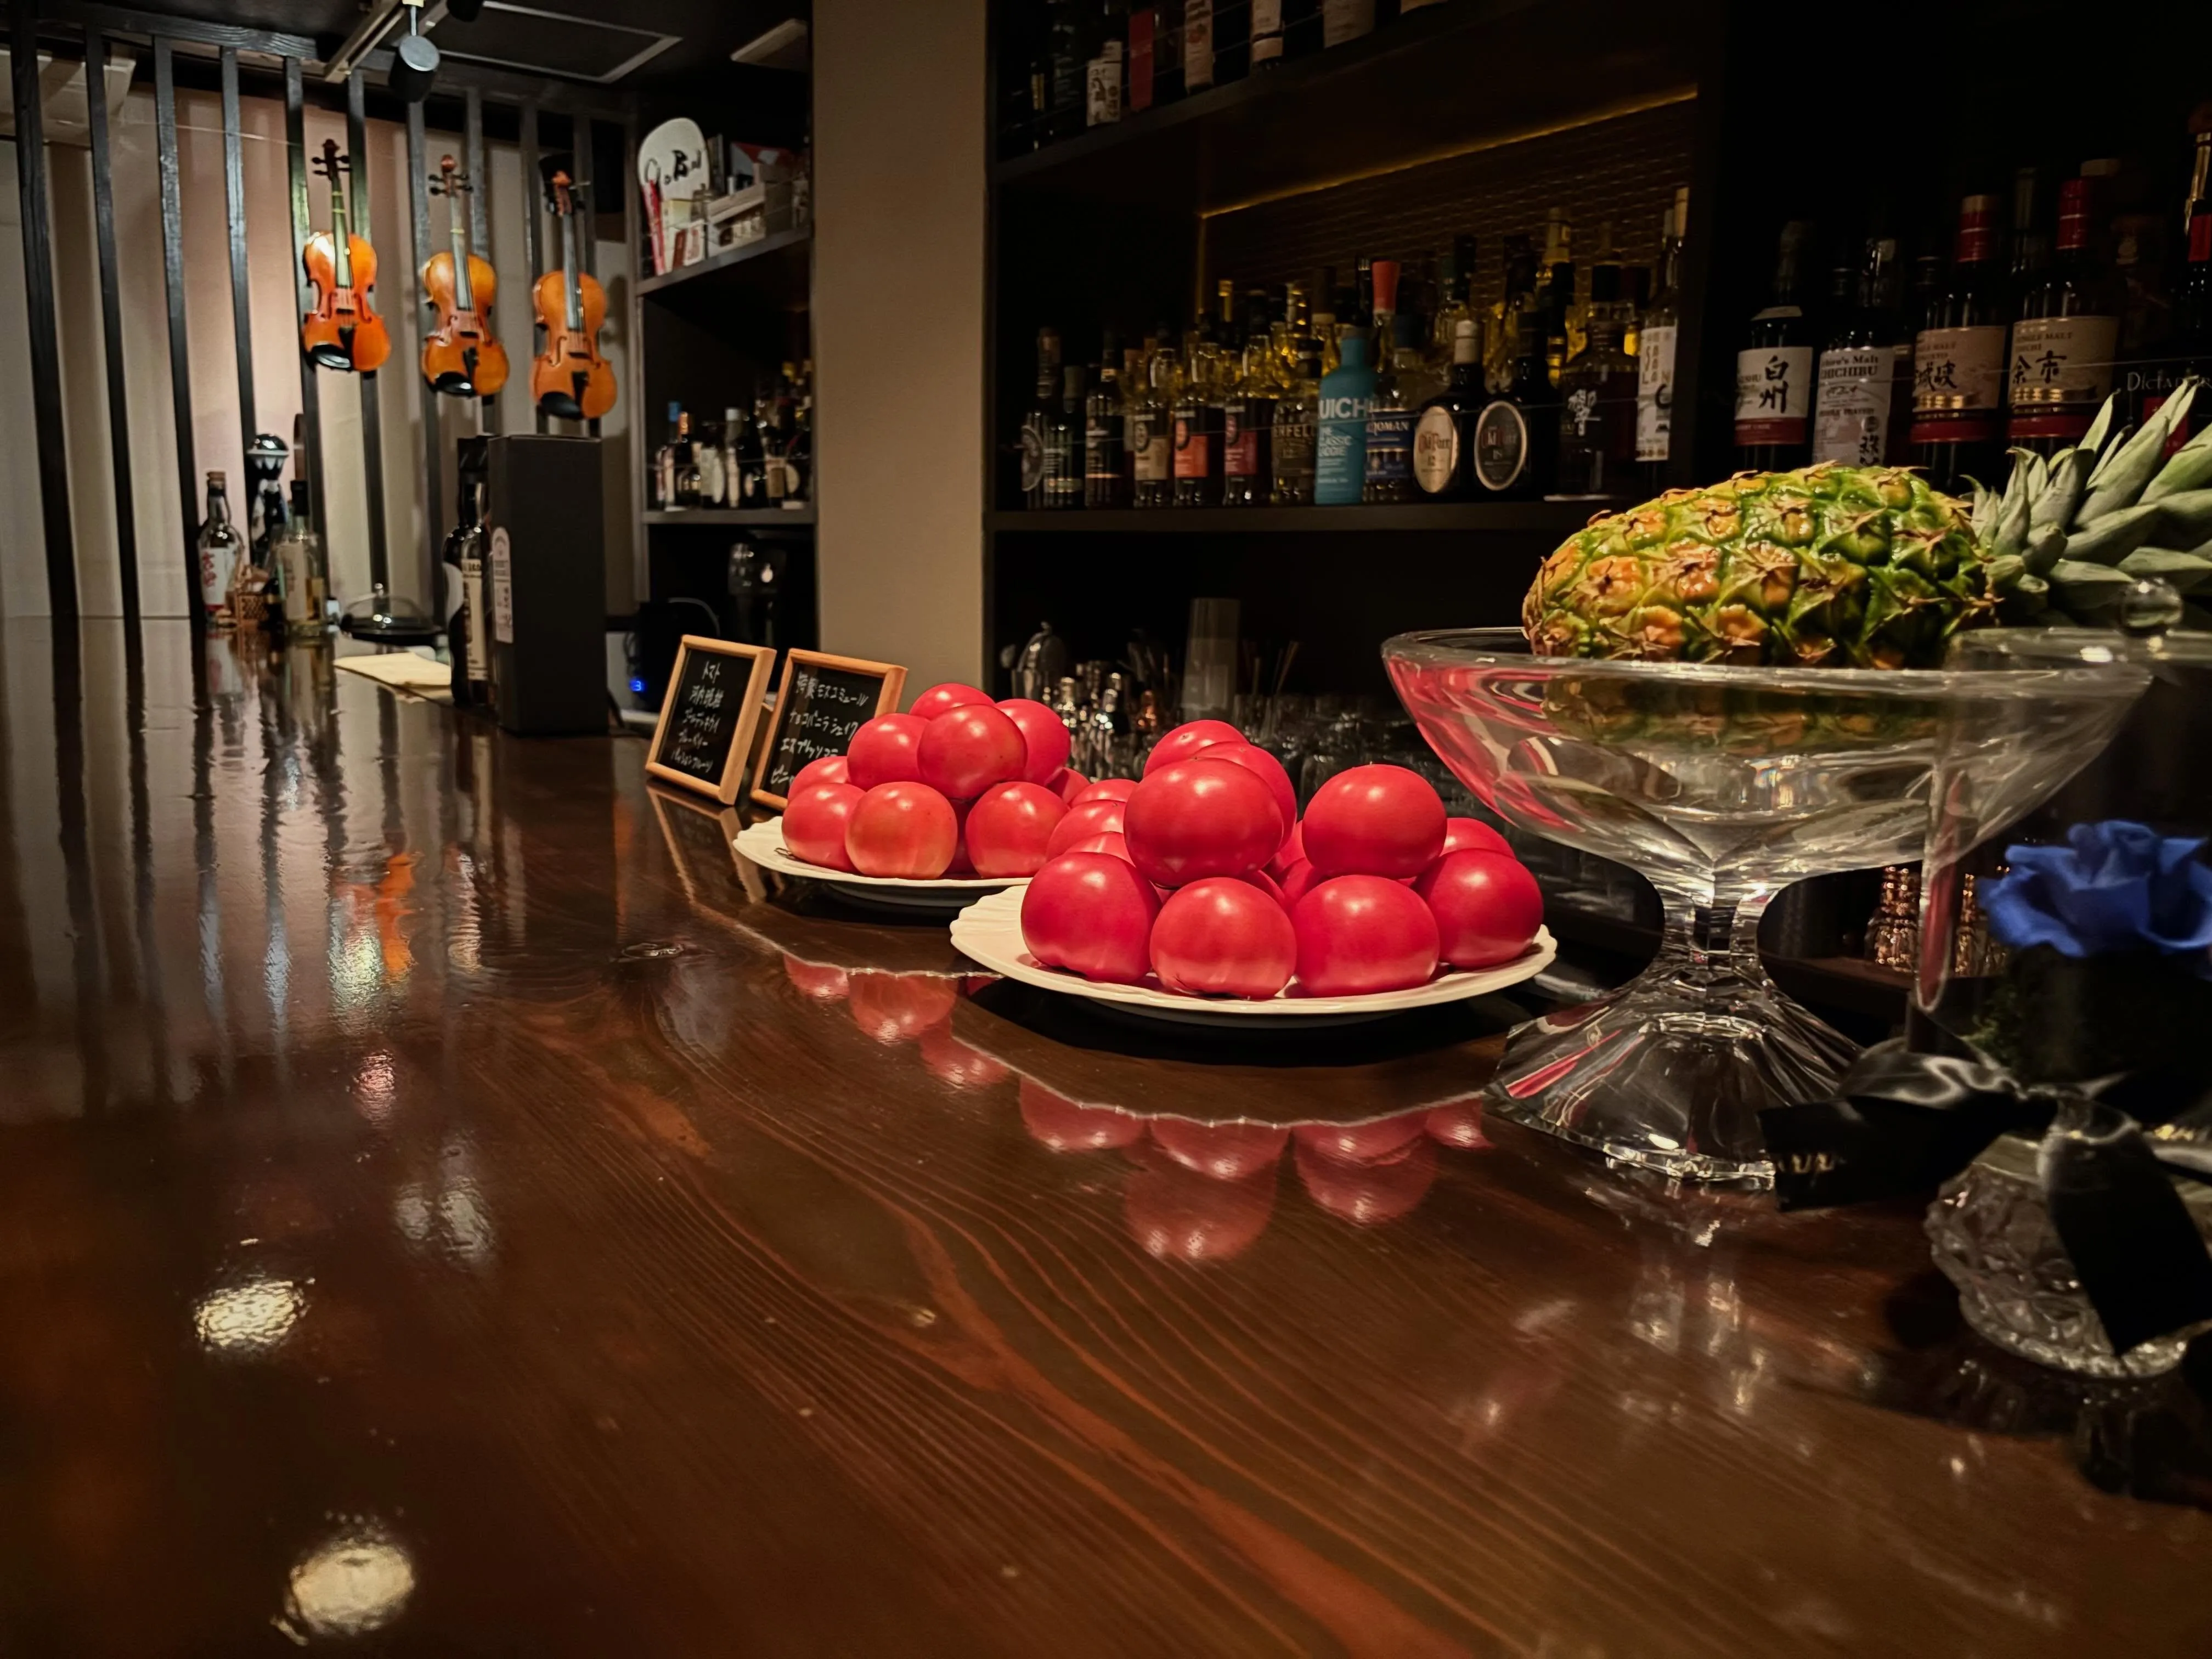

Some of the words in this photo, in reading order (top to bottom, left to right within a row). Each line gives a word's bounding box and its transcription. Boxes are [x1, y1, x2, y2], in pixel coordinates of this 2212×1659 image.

[1759, 356, 1788, 413] 白州
[1318, 397, 1369, 420] UICH
[702, 661, 721, 684] トマト
